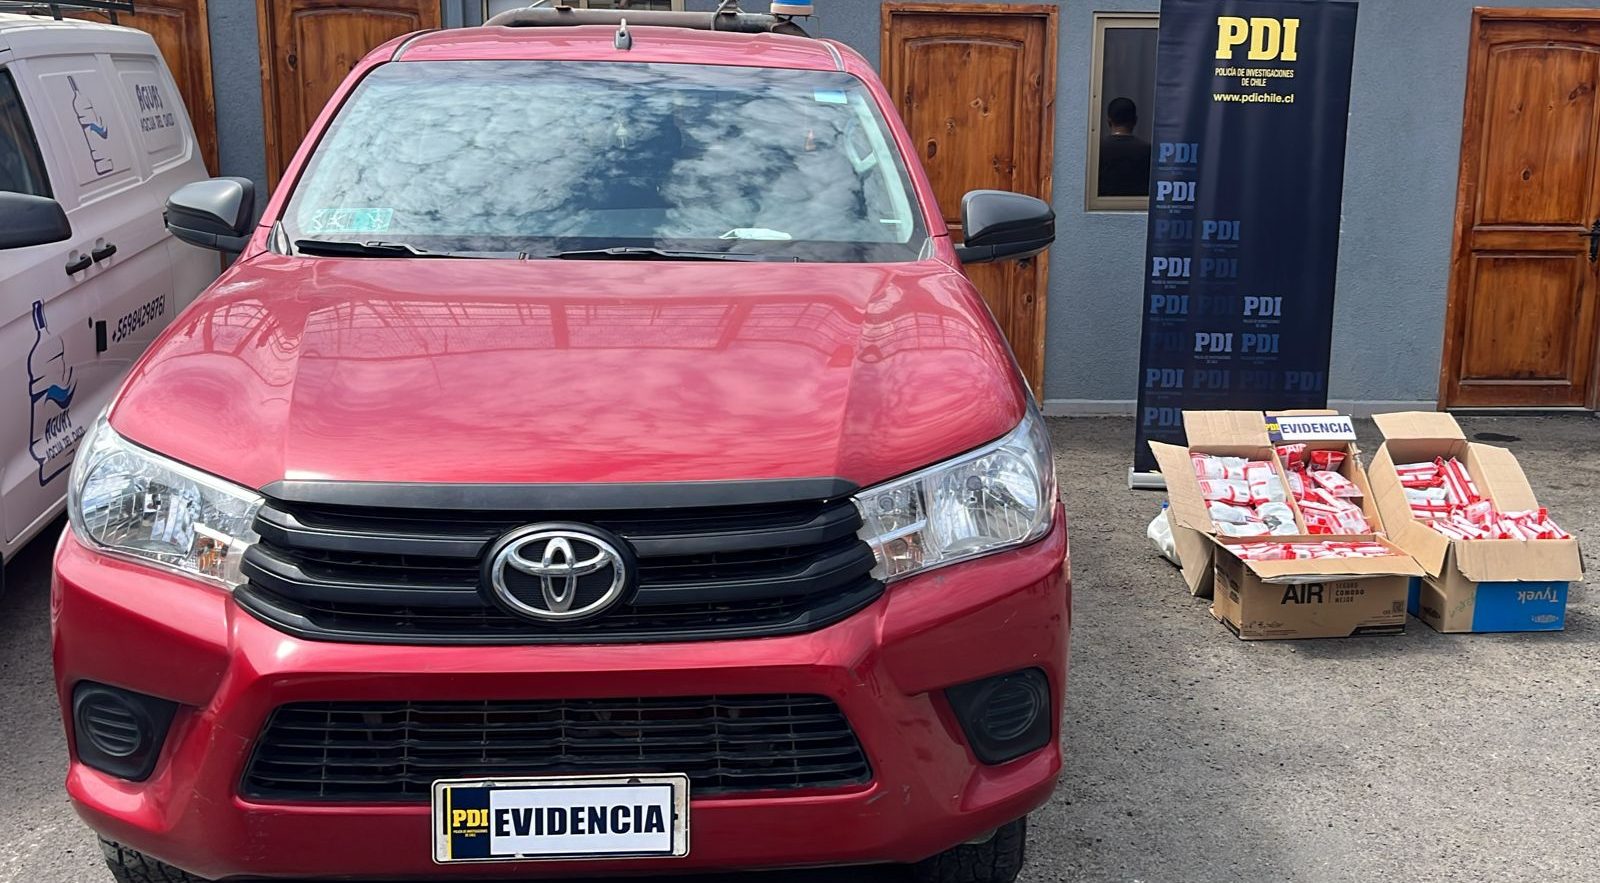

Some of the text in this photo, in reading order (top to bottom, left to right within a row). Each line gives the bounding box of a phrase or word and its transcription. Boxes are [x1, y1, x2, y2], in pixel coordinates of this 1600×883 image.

[1215, 16, 1300, 61] PDI
[1215, 67, 1294, 78] POLICÍA DE INVESTIGACIONES
[1241, 78, 1266, 87] DE CHILE
[1213, 93, 1295, 103] www.pdichile.cl
[1159, 143, 1198, 164] PDI
[1156, 181, 1195, 202] PDI
[1201, 220, 1240, 241] PDI
[1152, 257, 1191, 277] PDI
[1199, 257, 1237, 277] PDI
[1150, 294, 1190, 315] PDI
[1243, 297, 1282, 316] PDI
[1194, 333, 1233, 352] PDI
[1241, 333, 1279, 353] PDI
[1145, 369, 1184, 388] PDI
[1143, 407, 1182, 426] PDI
[1280, 422, 1353, 433] EVIDENCIA
[1281, 583, 1324, 605] AIR
[1517, 587, 1559, 604] Tyvek
[453, 804, 665, 837] PDI EVIDENCIA
